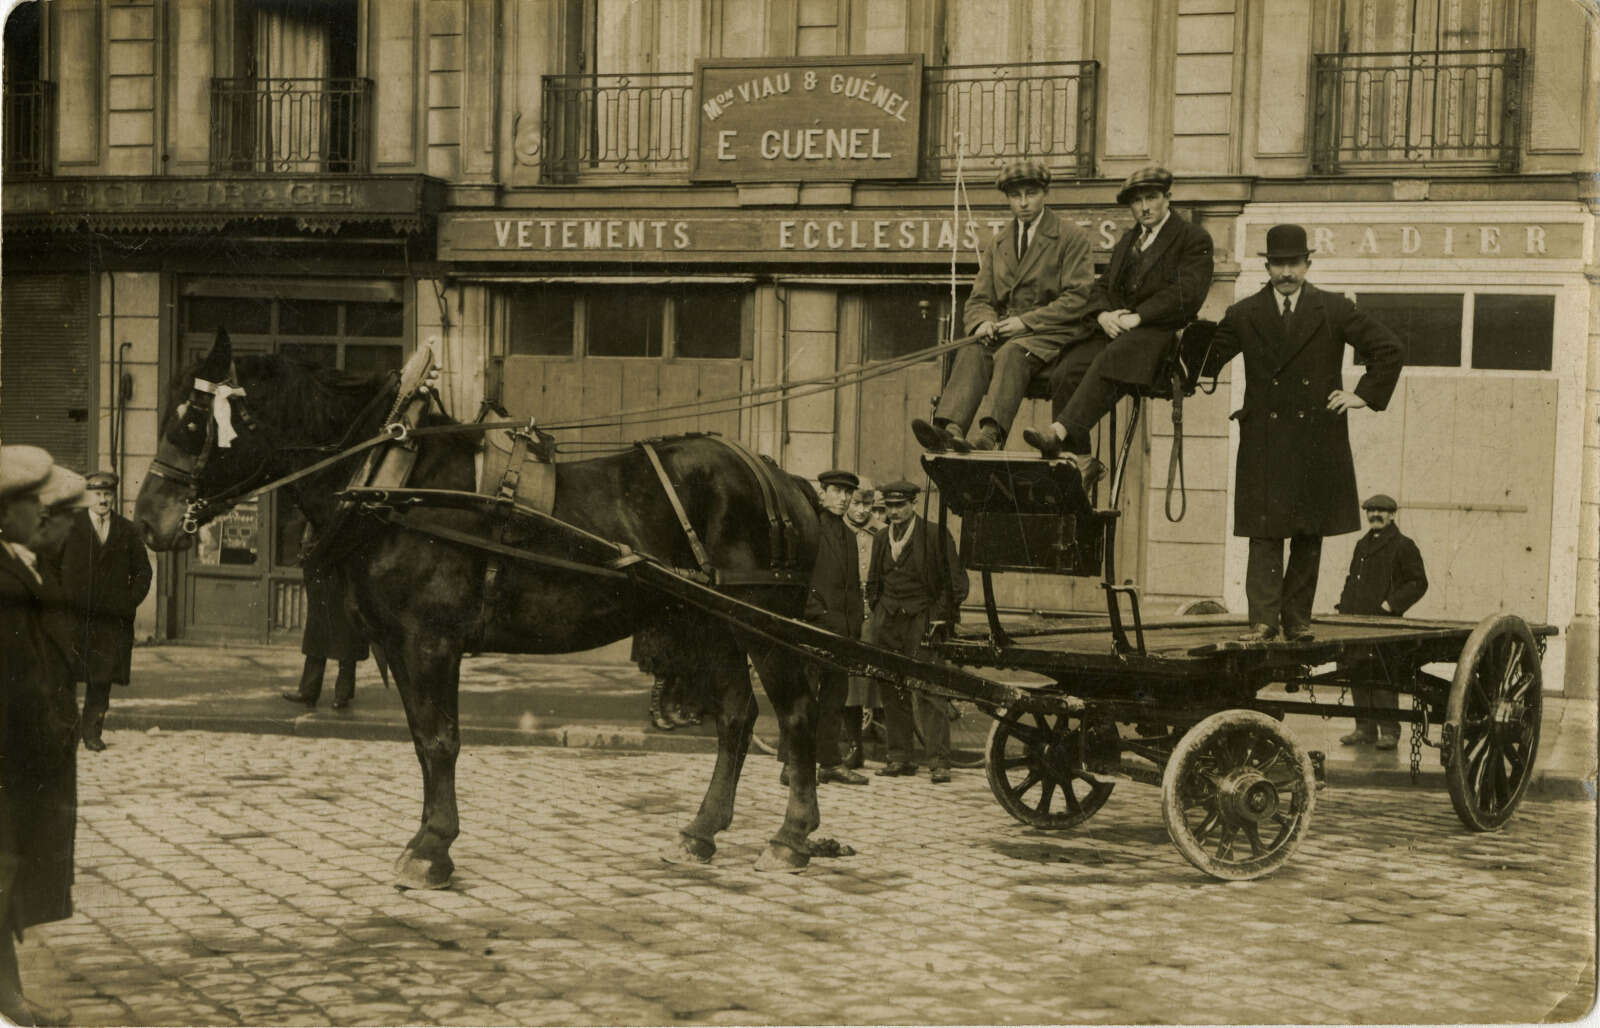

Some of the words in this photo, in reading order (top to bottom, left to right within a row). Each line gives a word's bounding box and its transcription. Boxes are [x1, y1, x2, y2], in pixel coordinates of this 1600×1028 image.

[738, 72, 791, 102] VIAU
[804, 71, 818, 91] &
[830, 72, 910, 123] GUÉNEL
[717, 130, 737, 160] E
[761, 118, 892, 160] GUÉNEL
[494, 220, 690, 249] VETEMENTS
[779, 220, 1116, 249] ECCLESIASTS
[1312, 226, 1548, 256] RADIER
